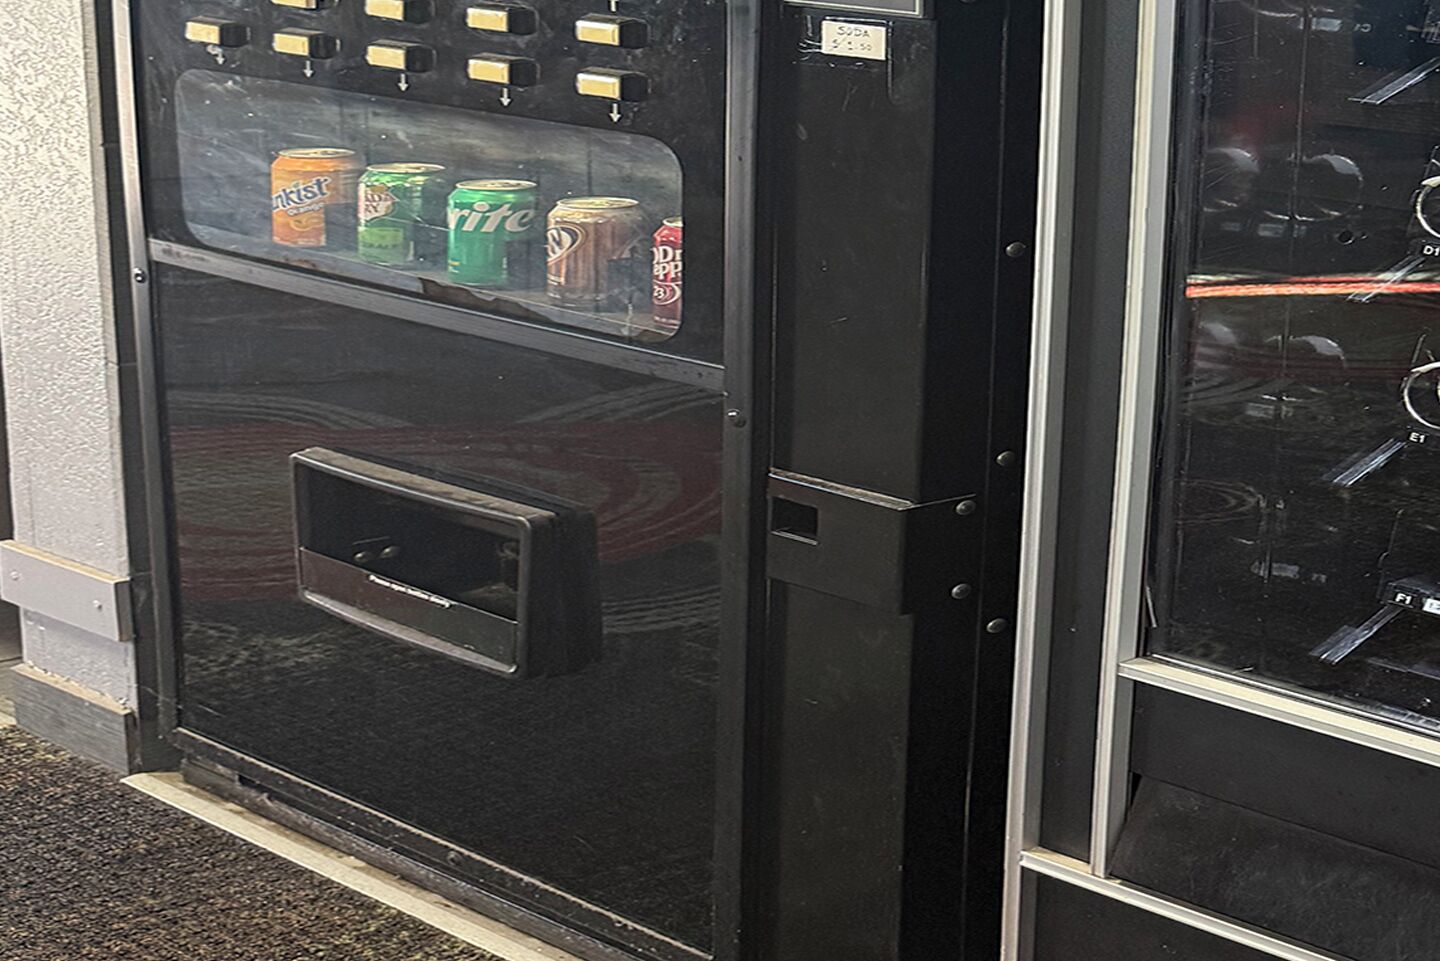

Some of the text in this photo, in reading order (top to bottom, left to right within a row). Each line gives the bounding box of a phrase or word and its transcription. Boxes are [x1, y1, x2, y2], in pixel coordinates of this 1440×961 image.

[448, 201, 534, 233] rite
[1423, 245, 1440, 256] D1
[1409, 432, 1426, 445] E1
[1395, 593, 1413, 605] F1
